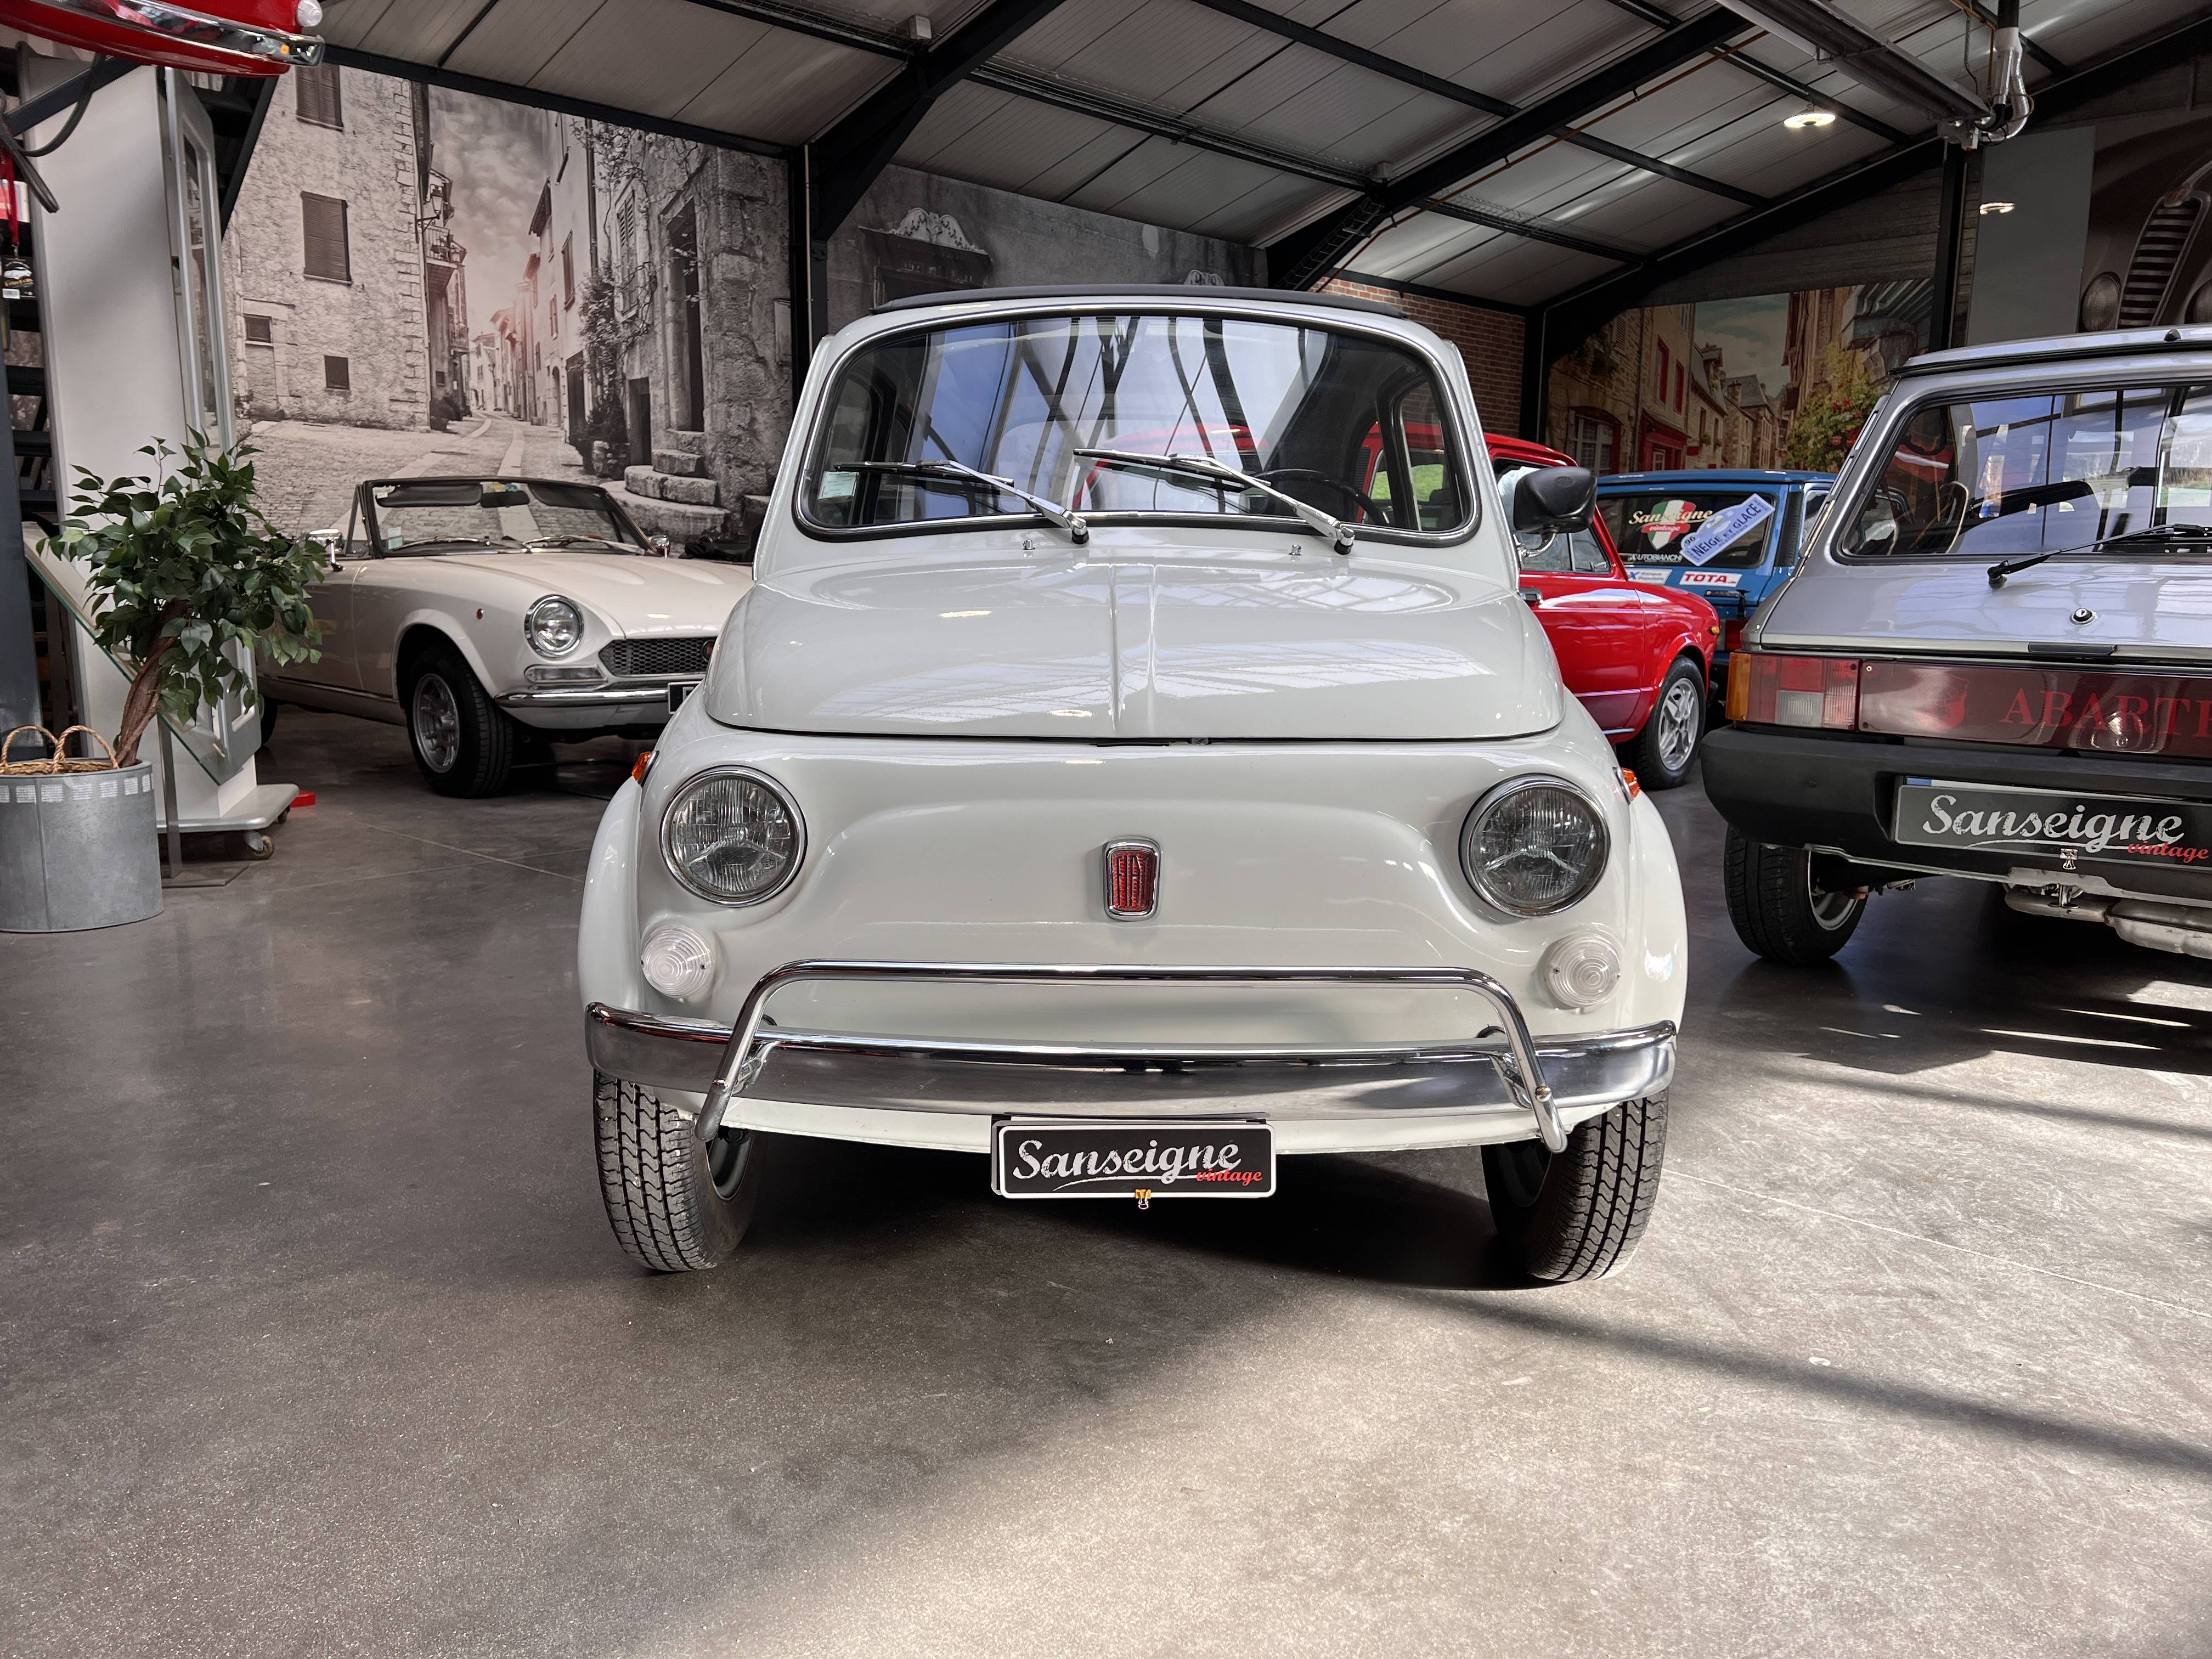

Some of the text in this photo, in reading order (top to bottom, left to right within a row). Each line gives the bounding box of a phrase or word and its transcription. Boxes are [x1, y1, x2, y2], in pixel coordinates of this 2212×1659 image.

[1691, 534, 1723, 557] NEIGE
[1723, 529, 1733, 539] ET
[1733, 503, 1762, 529] GLACE
[1922, 794, 2210, 864] Sanseigne vintage
[1013, 1139, 1263, 1186] Sanseigne vintage
